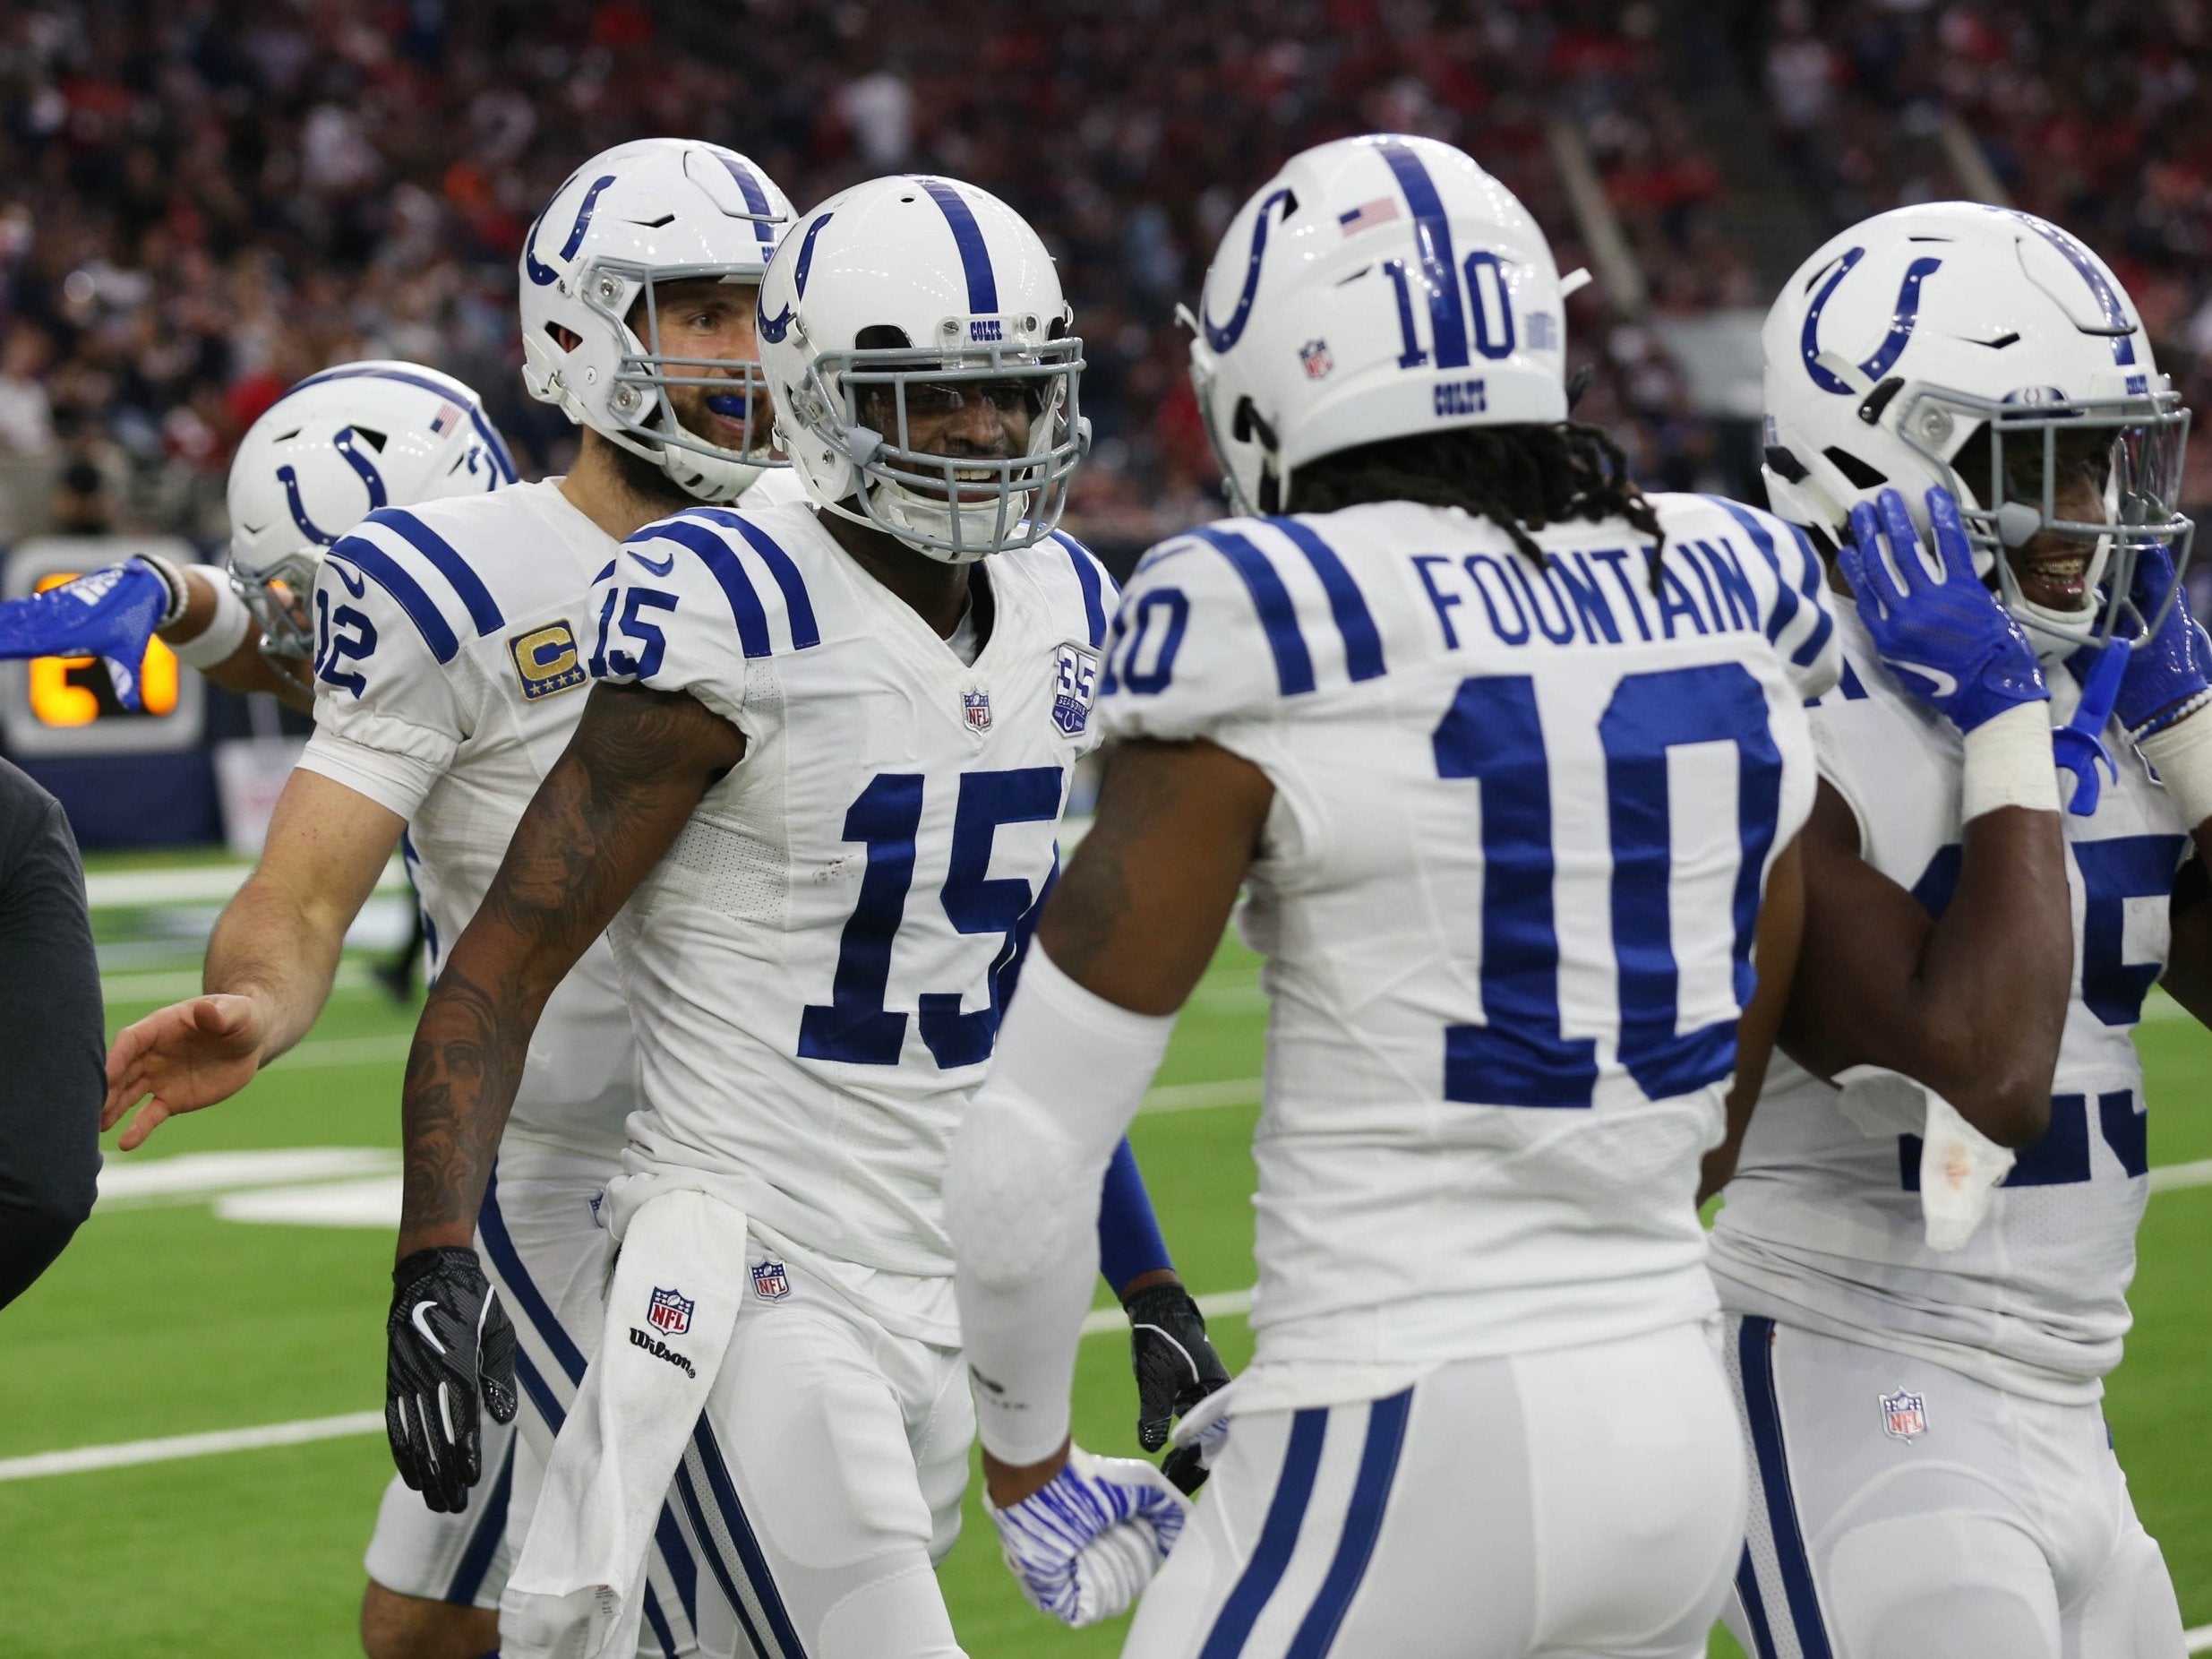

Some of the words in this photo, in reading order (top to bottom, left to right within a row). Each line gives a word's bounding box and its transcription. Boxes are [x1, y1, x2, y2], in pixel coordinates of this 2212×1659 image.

[970, 321, 1003, 341] COLTS
[1384, 251, 1515, 369] 10
[1410, 537, 1760, 650] FOUNTAIN
[315, 589, 377, 699] 12
[515, 626, 578, 682] C
[588, 587, 680, 681] 15
[1057, 645, 1097, 709] 35
[1058, 695, 1087, 716] SEASONS
[968, 708, 990, 726] NFL
[1431, 661, 1783, 1108] 10
[797, 767, 1064, 1070] 15
[651, 1303, 685, 1331] NFL
[758, 1277, 786, 1294] NFL
